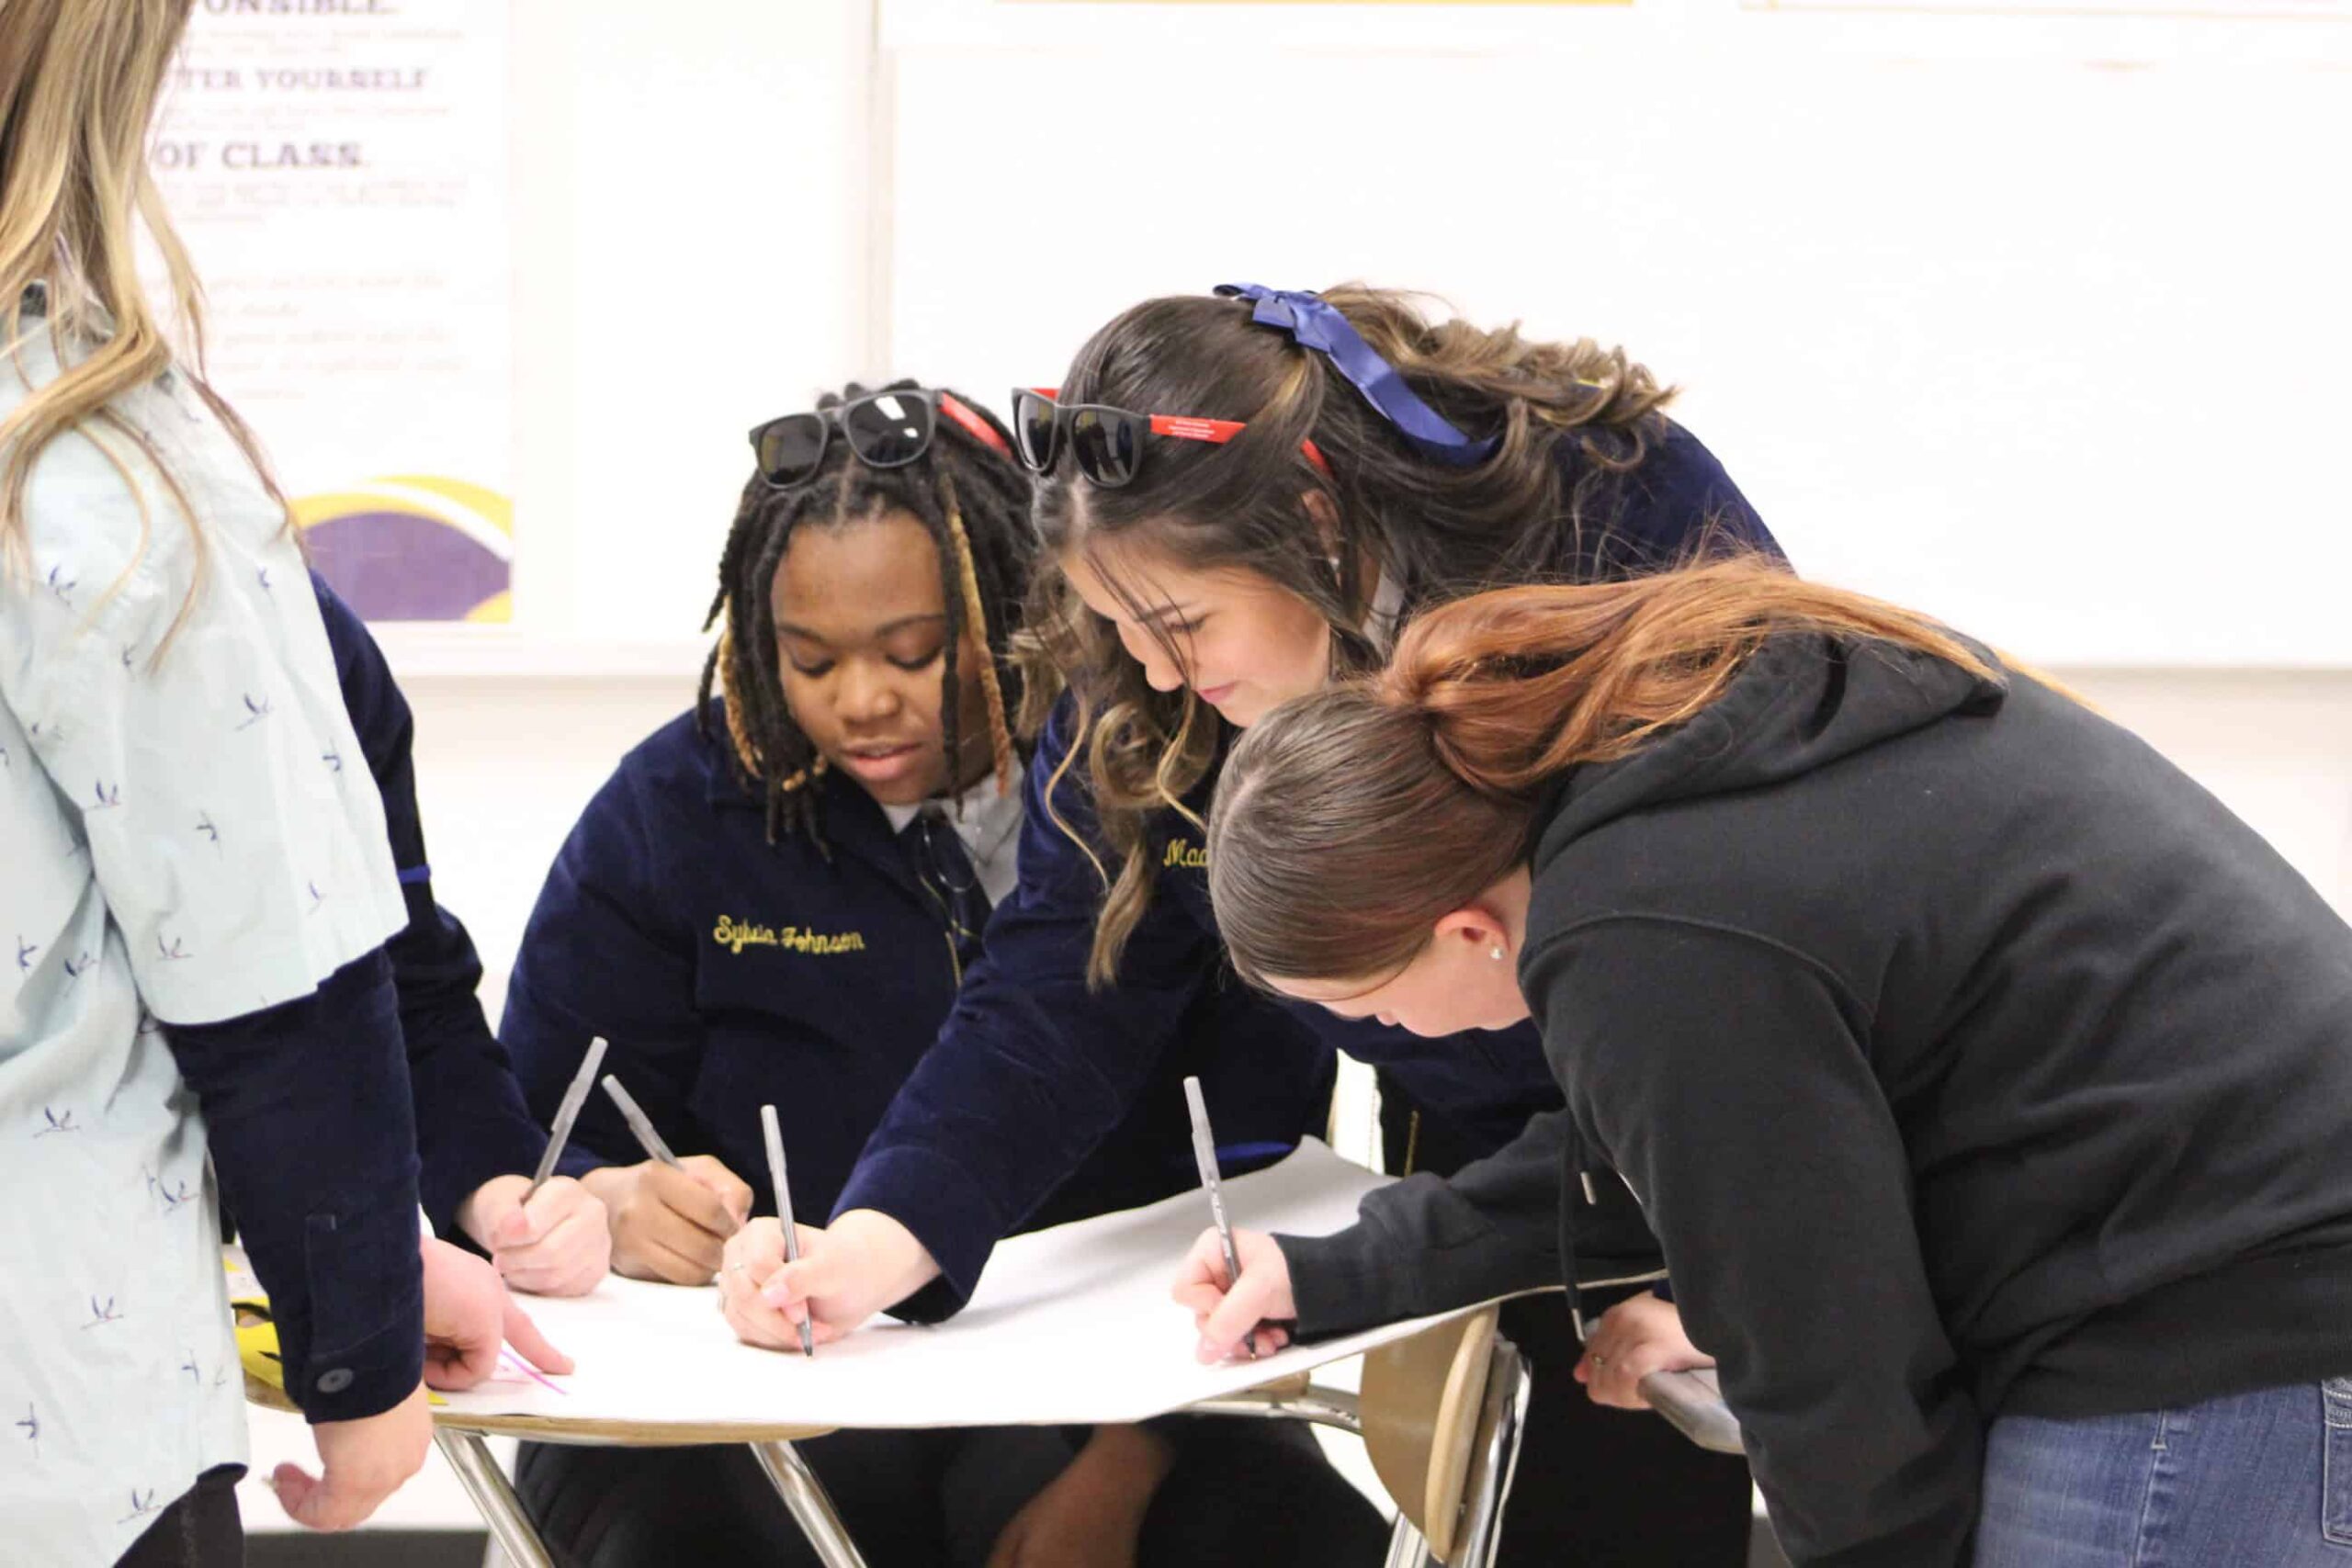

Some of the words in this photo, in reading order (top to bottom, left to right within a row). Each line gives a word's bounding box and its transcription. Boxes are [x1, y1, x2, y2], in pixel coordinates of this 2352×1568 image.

[255, 67, 432, 90] YOURSELF
[156, 141, 209, 170] OF
[713, 914, 778, 954] Sylvia
[781, 926, 866, 954] Johnson
